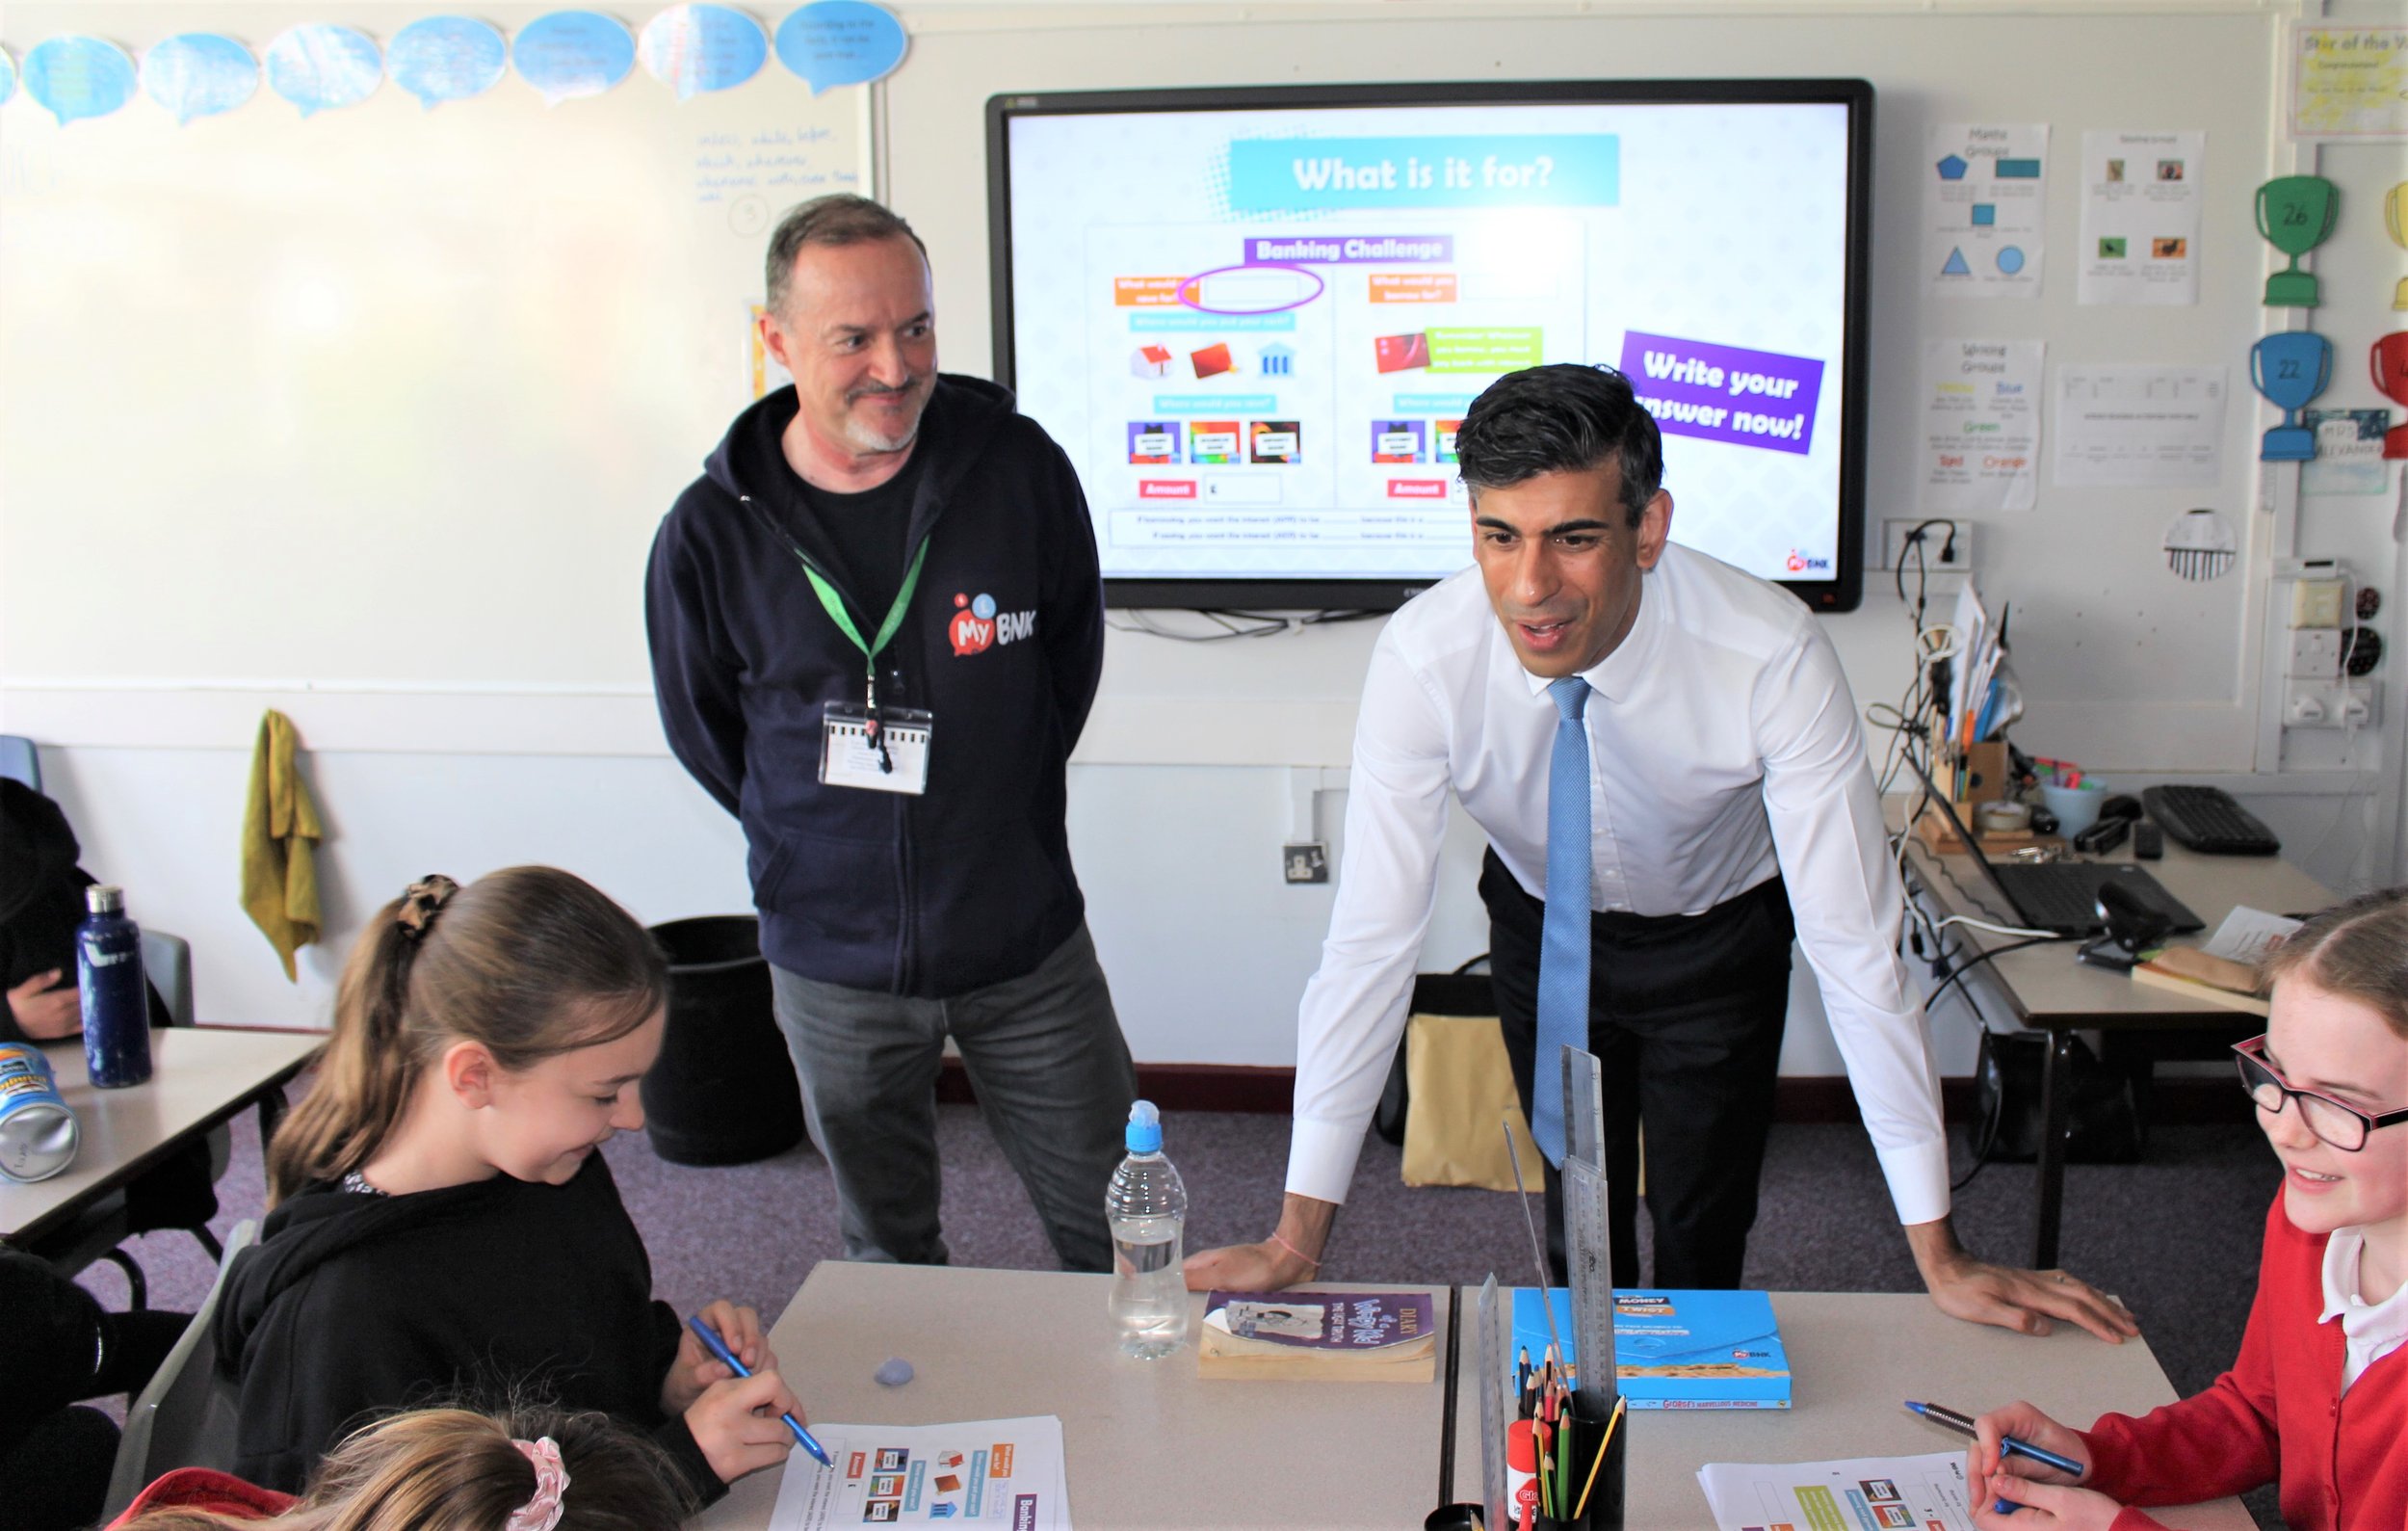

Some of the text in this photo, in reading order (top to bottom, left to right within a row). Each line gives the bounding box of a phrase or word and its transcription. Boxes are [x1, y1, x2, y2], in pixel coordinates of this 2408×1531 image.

[1293, 155, 1555, 191] What is it for?
[2282, 202, 2309, 226] 26
[1256, 238, 1444, 261] Banking Challenge
[1643, 350, 1800, 401] Write your
[2279, 359, 2300, 379] 22
[1732, 411, 1805, 442] now!
[1963, 420, 2002, 434] Green
[1145, 483, 1191, 495] Amount
[1394, 483, 1440, 495] Amount
[957, 610, 1036, 647] My BNK
[1378, 1314, 1398, 1323] of
[1400, 1307, 1418, 1334] DIARY
[1352, 1329, 1385, 1344] Kid
[851, 1456, 862, 1475] Amount
